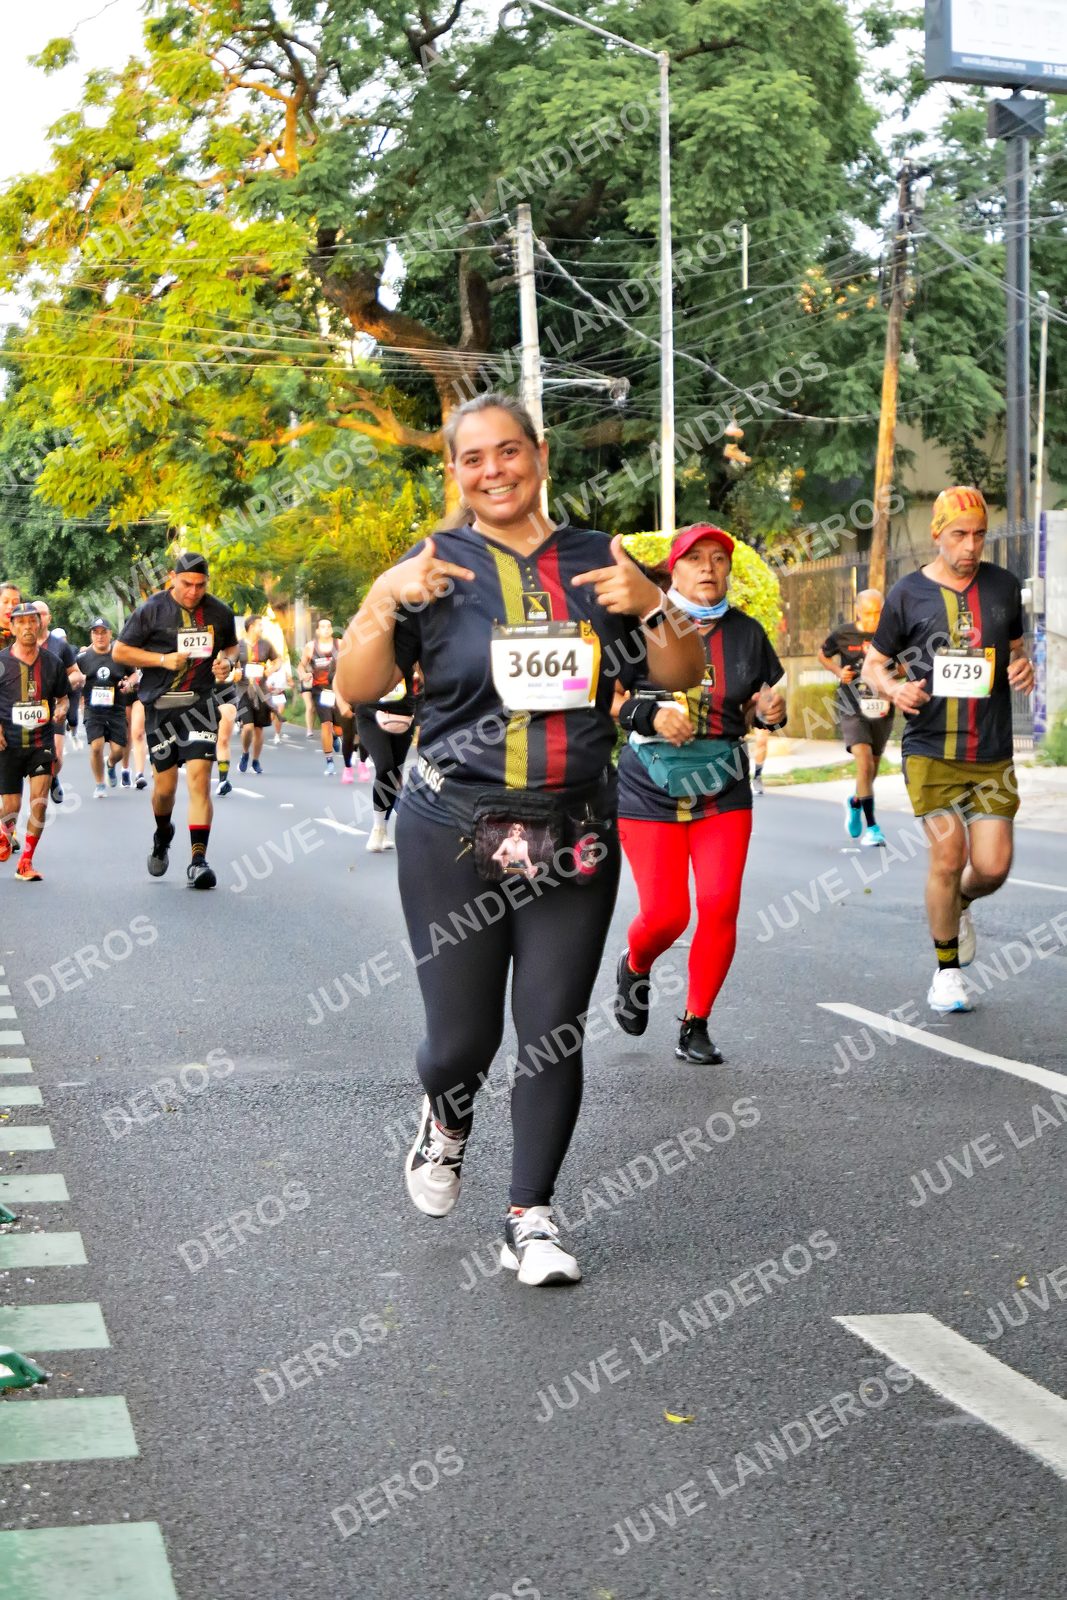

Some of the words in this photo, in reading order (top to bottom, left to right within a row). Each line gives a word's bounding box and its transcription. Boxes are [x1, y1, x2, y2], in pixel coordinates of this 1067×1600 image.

[183, 636, 208, 648] 6212
[508, 650, 579, 678] 3664
[942, 664, 982, 680] 6739
[18, 709, 43, 721] 1640
